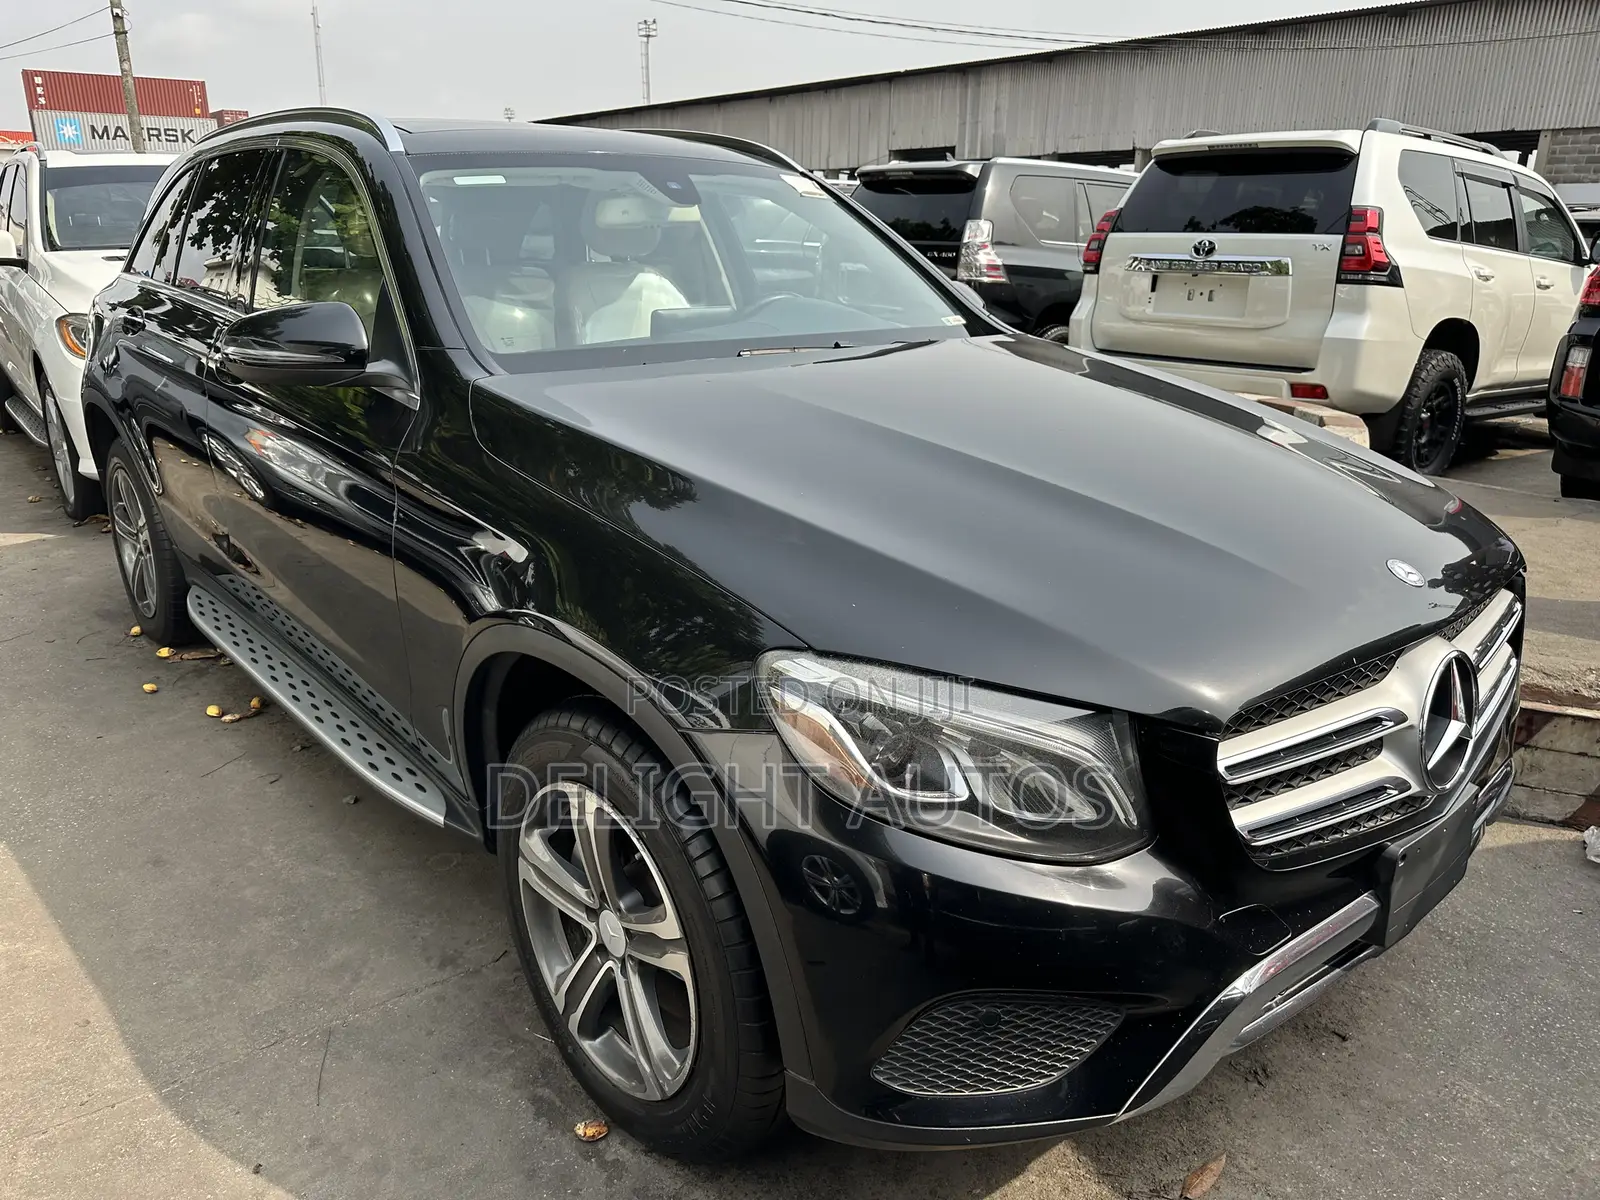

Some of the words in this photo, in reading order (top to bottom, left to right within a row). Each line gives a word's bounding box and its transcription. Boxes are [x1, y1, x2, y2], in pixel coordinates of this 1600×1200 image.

[90, 124, 196, 143] MARSK
[1172, 261, 1218, 270] CRUISER
[1220, 262, 1262, 271] PRADO
